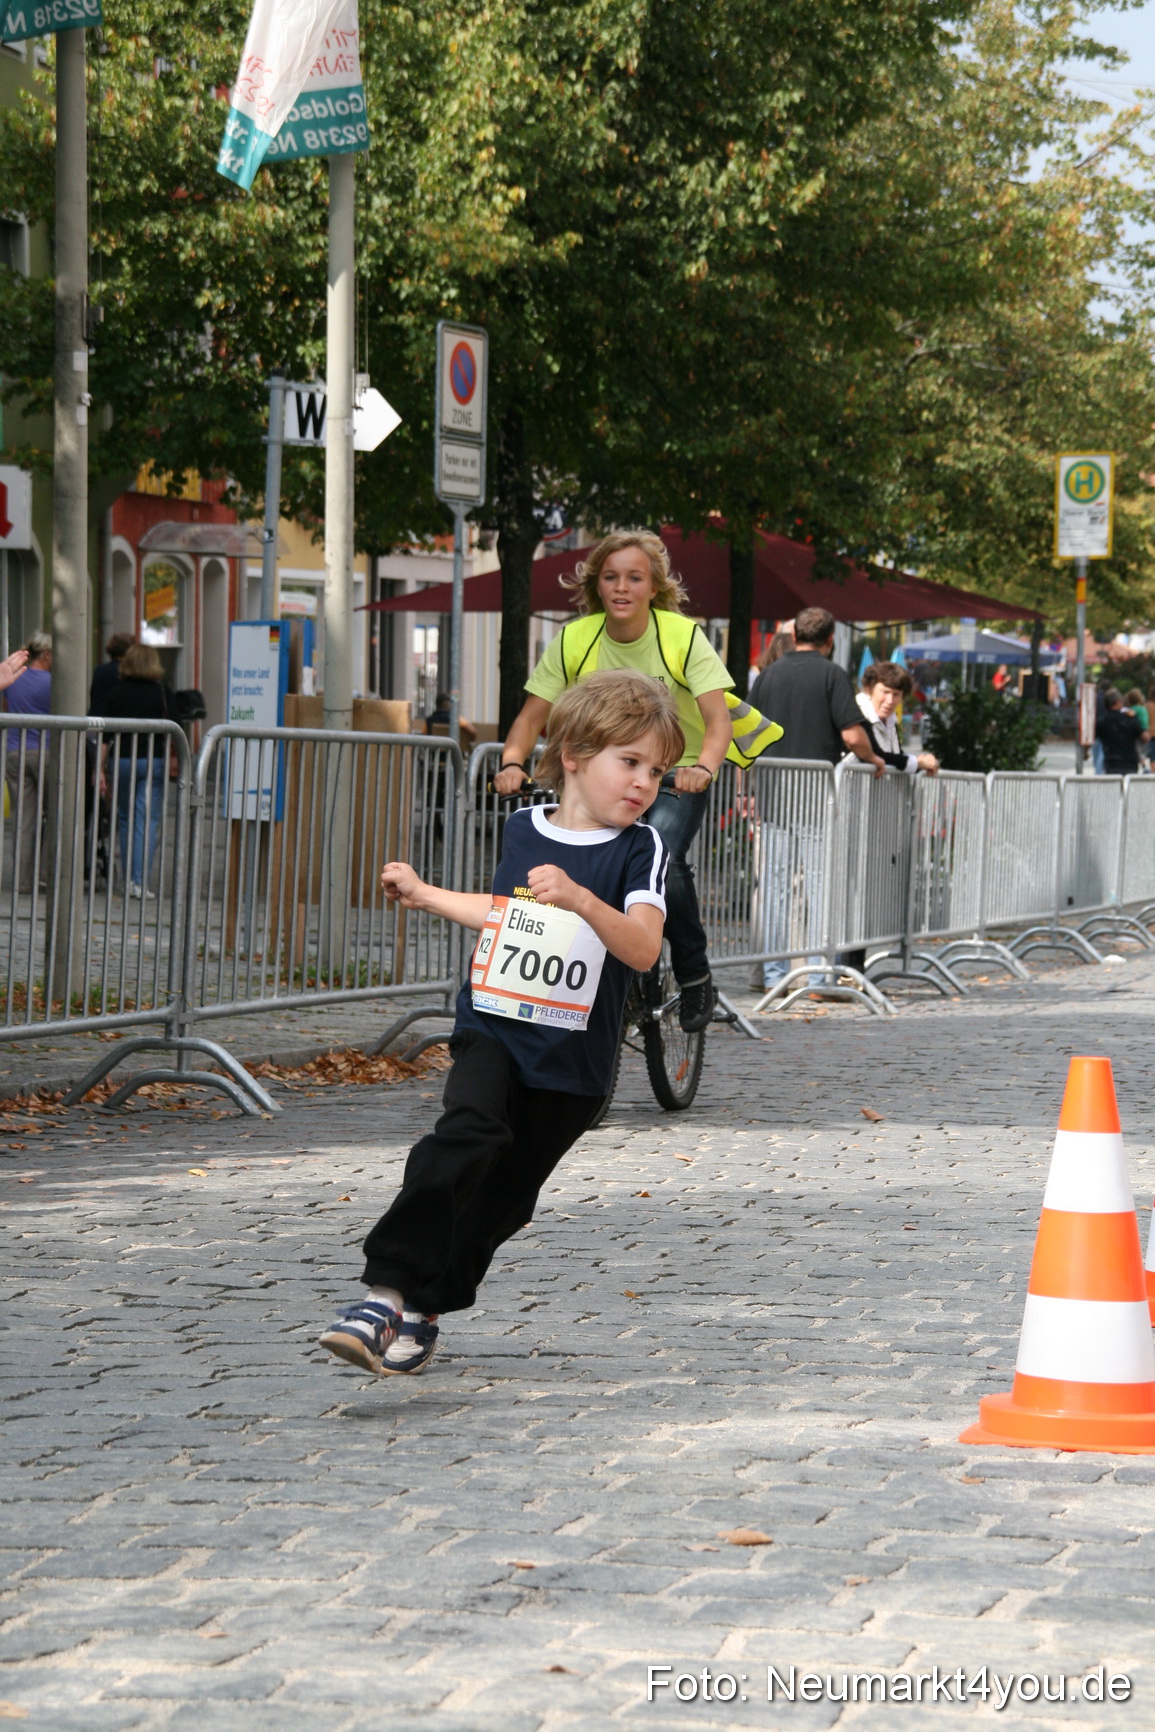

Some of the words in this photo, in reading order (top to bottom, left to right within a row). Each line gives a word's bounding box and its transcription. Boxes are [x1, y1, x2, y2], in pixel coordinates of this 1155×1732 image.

[452, 409, 473, 427] ZONE
[1075, 471, 1094, 494] H
[232, 667, 242, 678] Was
[243, 669, 257, 678] unser
[258, 667, 270, 679] Land
[232, 684, 243, 698] jetzt
[231, 705, 255, 721] Zukunft
[507, 908, 545, 936] Elias
[479, 937, 492, 954] K2
[499, 944, 587, 991] 7000
[535, 1006, 587, 1022] PFLEIDERER
